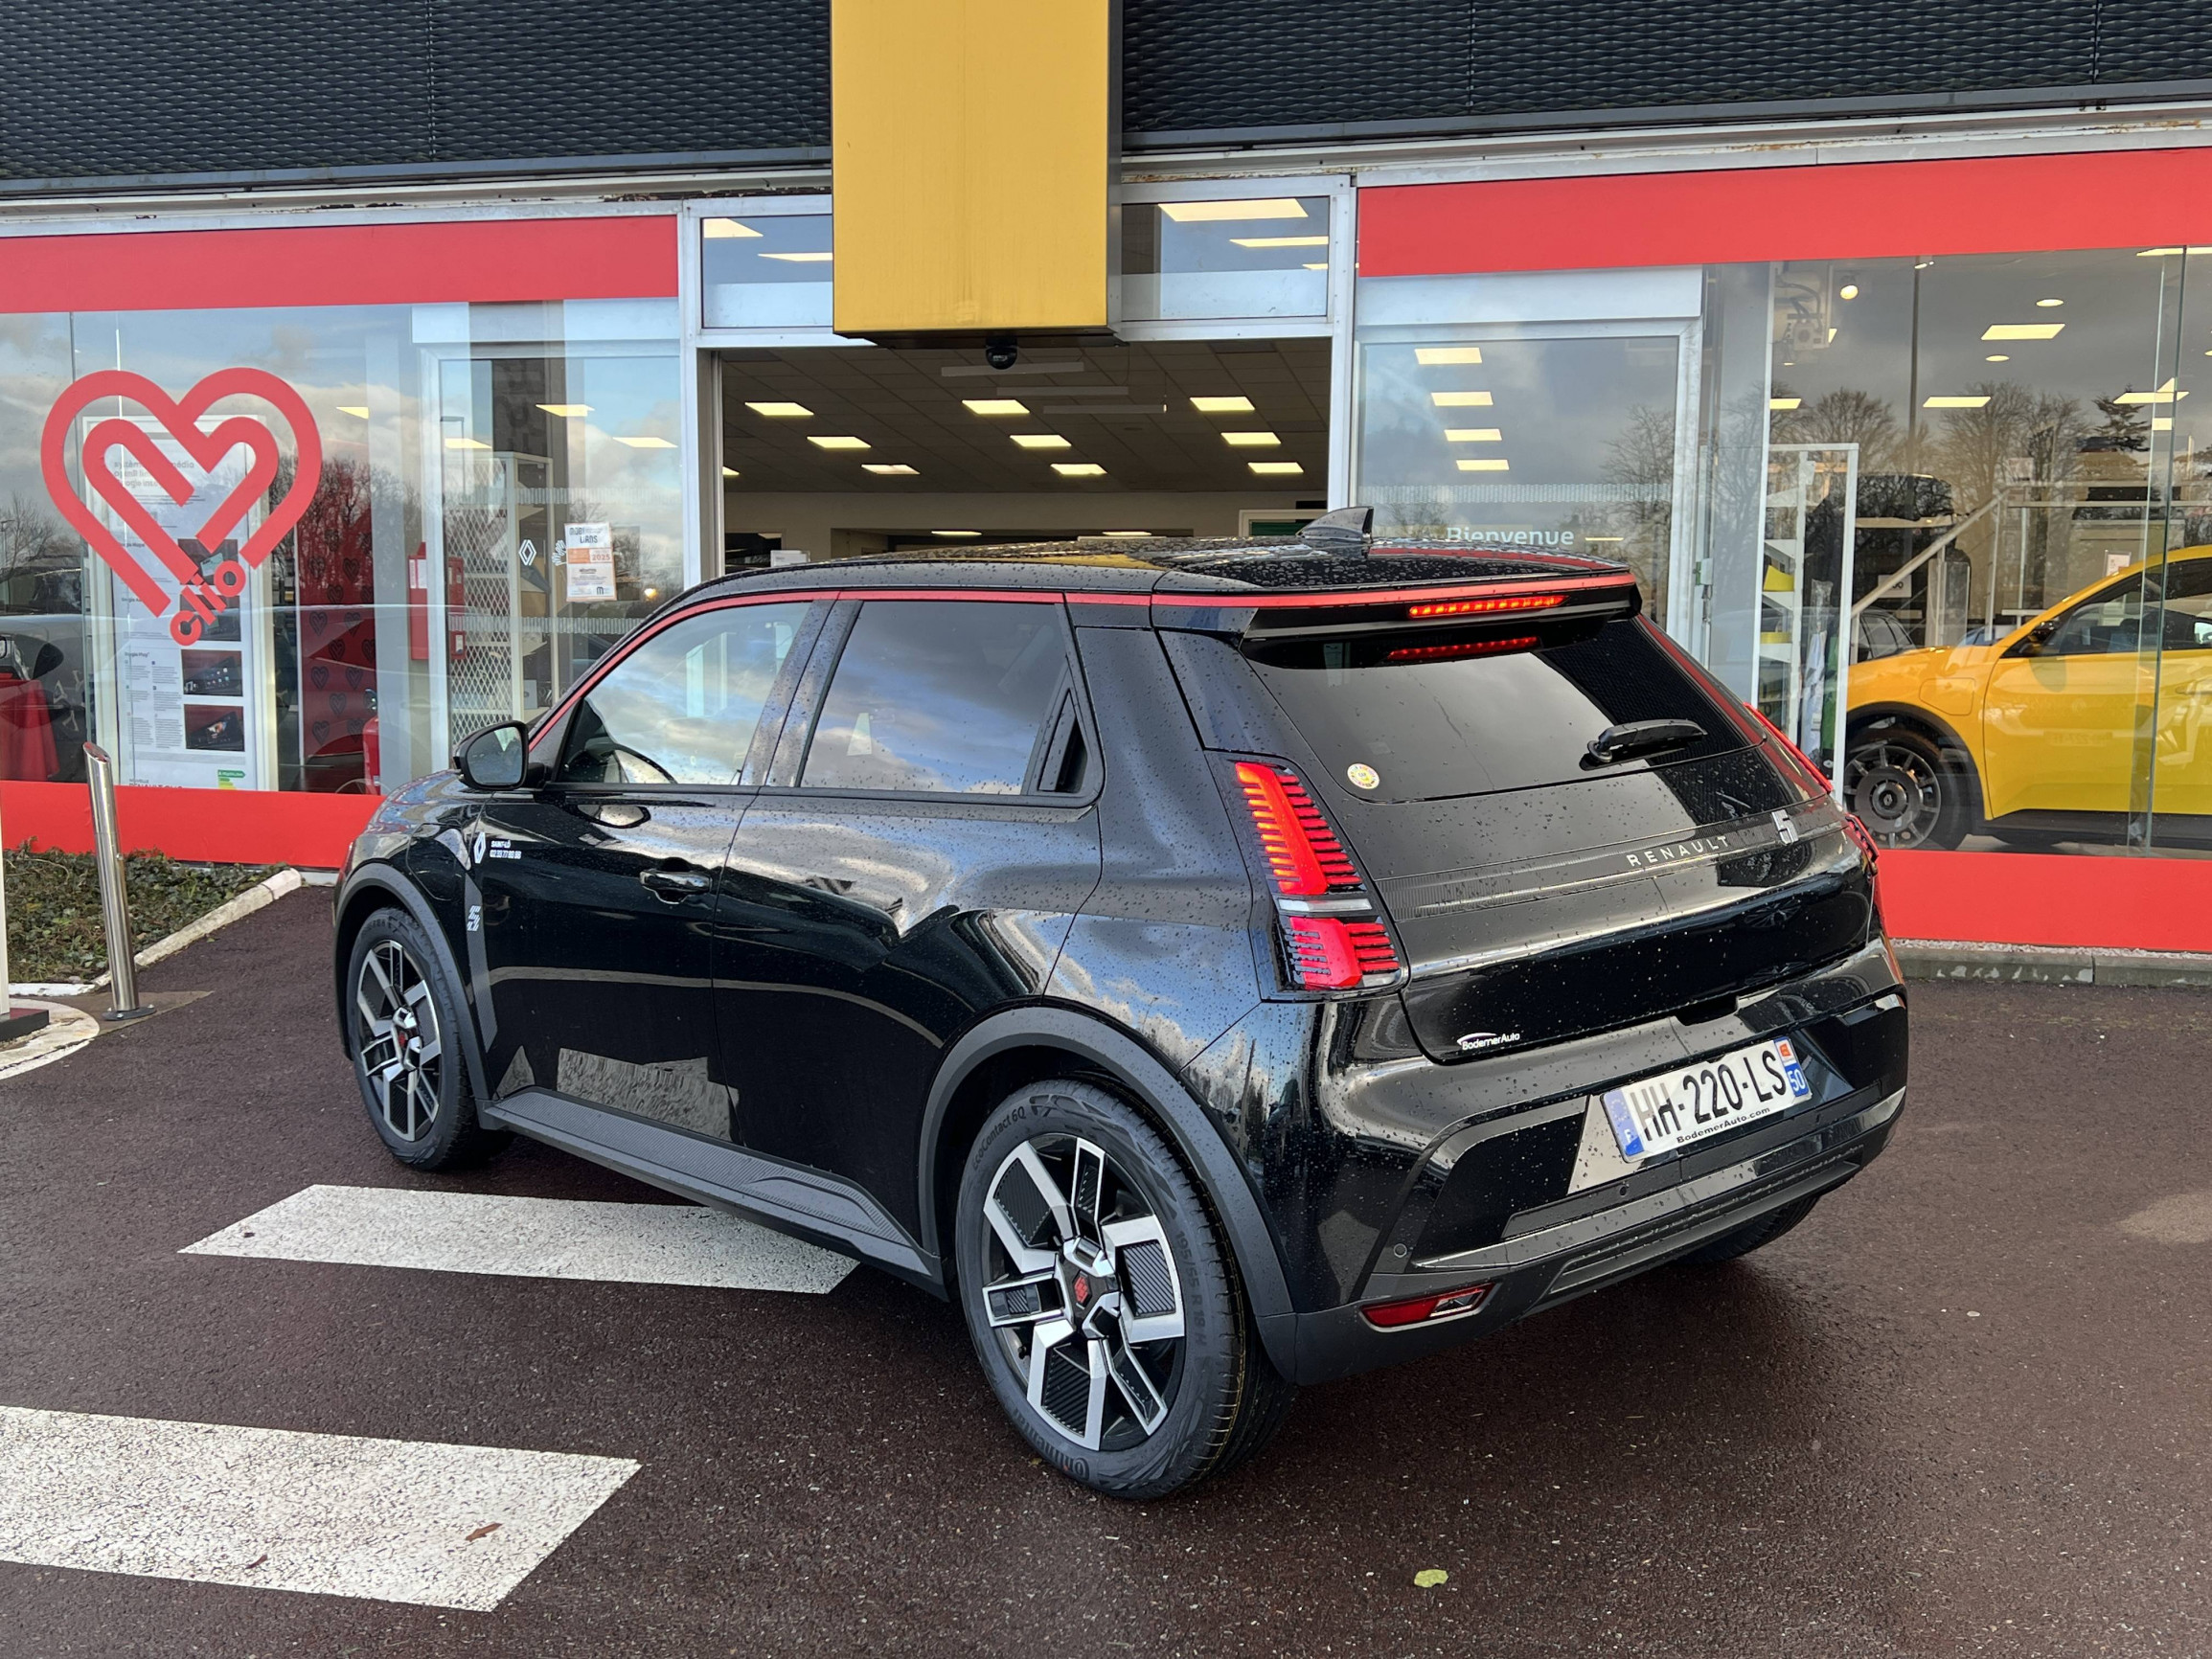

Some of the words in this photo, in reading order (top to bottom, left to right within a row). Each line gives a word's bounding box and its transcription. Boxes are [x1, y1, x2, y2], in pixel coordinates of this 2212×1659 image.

[1447, 527, 1574, 544] Bienvenue
[170, 560, 246, 647] clio
[1626, 835, 1731, 867] RENAULT
[1462, 1033, 1520, 1051] BodemerAuto
[1630, 1050, 1787, 1142] HH-220-LS
[1788, 1069, 1806, 1092] 50
[972, 1114, 1012, 1170] EcoContact
[1012, 1106, 1027, 1123] 6Q
[1676, 1106, 1770, 1145] BodemerAuto.com
